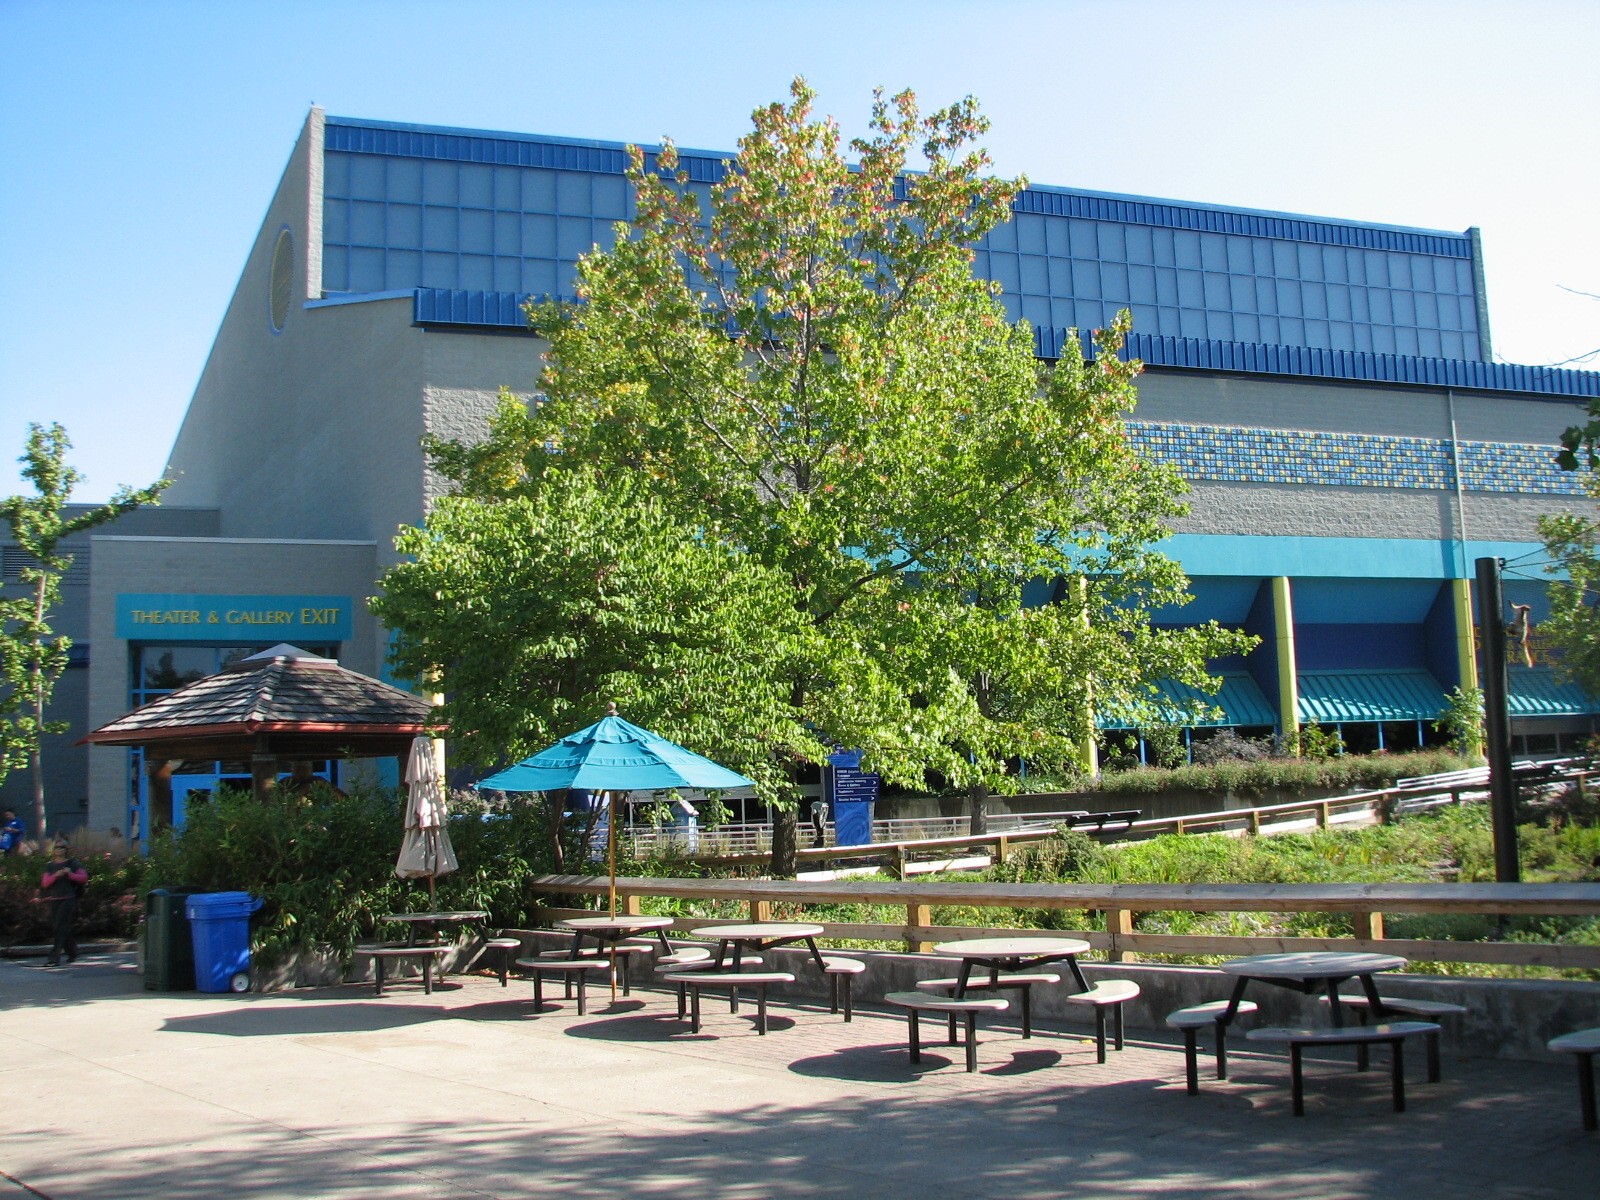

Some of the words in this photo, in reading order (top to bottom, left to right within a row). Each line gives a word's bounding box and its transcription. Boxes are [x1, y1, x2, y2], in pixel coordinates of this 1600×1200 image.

[131, 610, 200, 625] THEATER
[207, 610, 220, 625] &
[225, 610, 294, 625] GALLERY
[300, 608, 340, 625] EXIT
